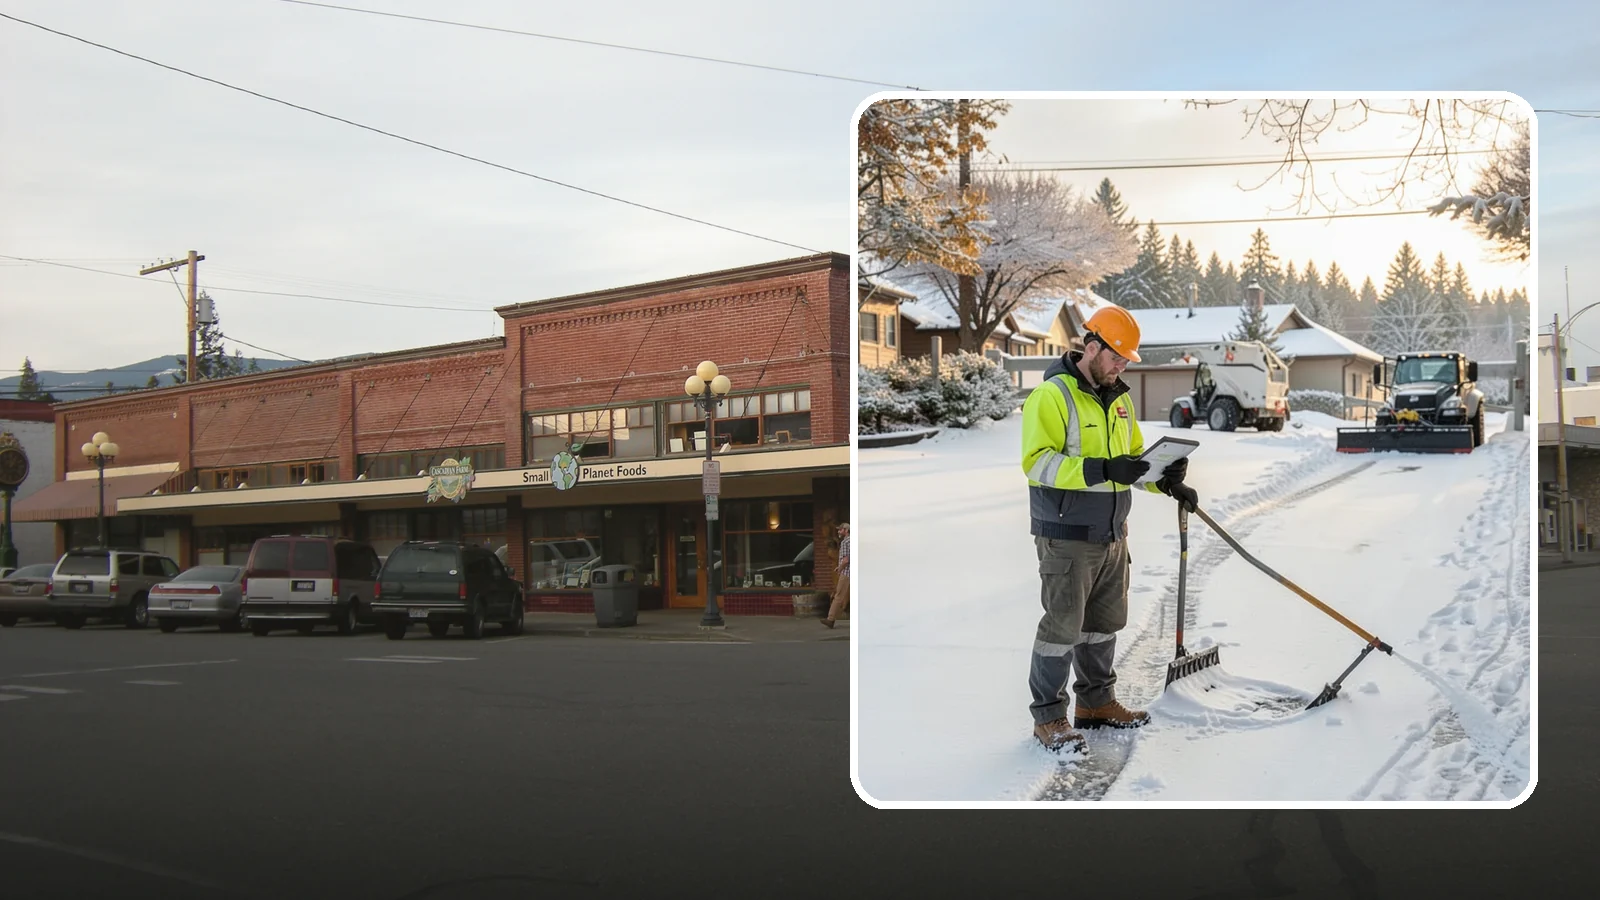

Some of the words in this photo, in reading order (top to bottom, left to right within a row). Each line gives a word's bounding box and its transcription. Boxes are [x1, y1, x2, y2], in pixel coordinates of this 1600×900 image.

[523, 471, 549, 483] Small
[583, 467, 614, 479] Planet
[617, 464, 647, 477] Foods
